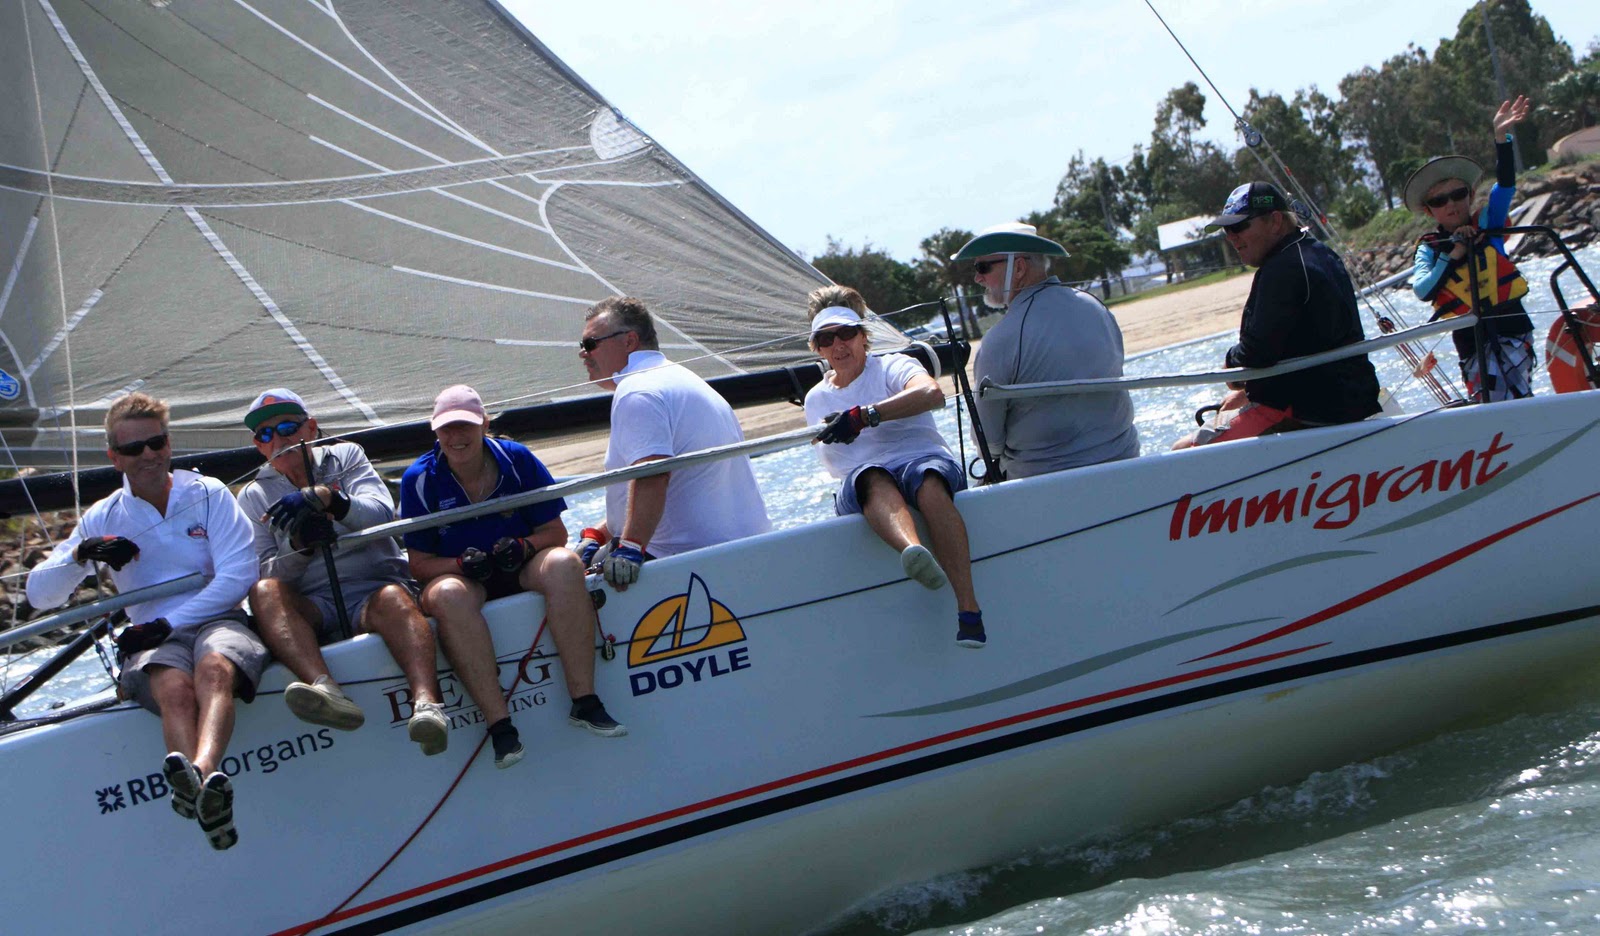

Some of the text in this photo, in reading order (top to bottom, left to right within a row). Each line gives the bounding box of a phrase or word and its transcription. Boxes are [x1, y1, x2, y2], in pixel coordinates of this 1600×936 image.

[1169, 431, 1513, 541] Immigrant
[382, 649, 552, 724] BEG
[629, 646, 751, 697] DOYLE
[127, 728, 335, 805] RB organs
